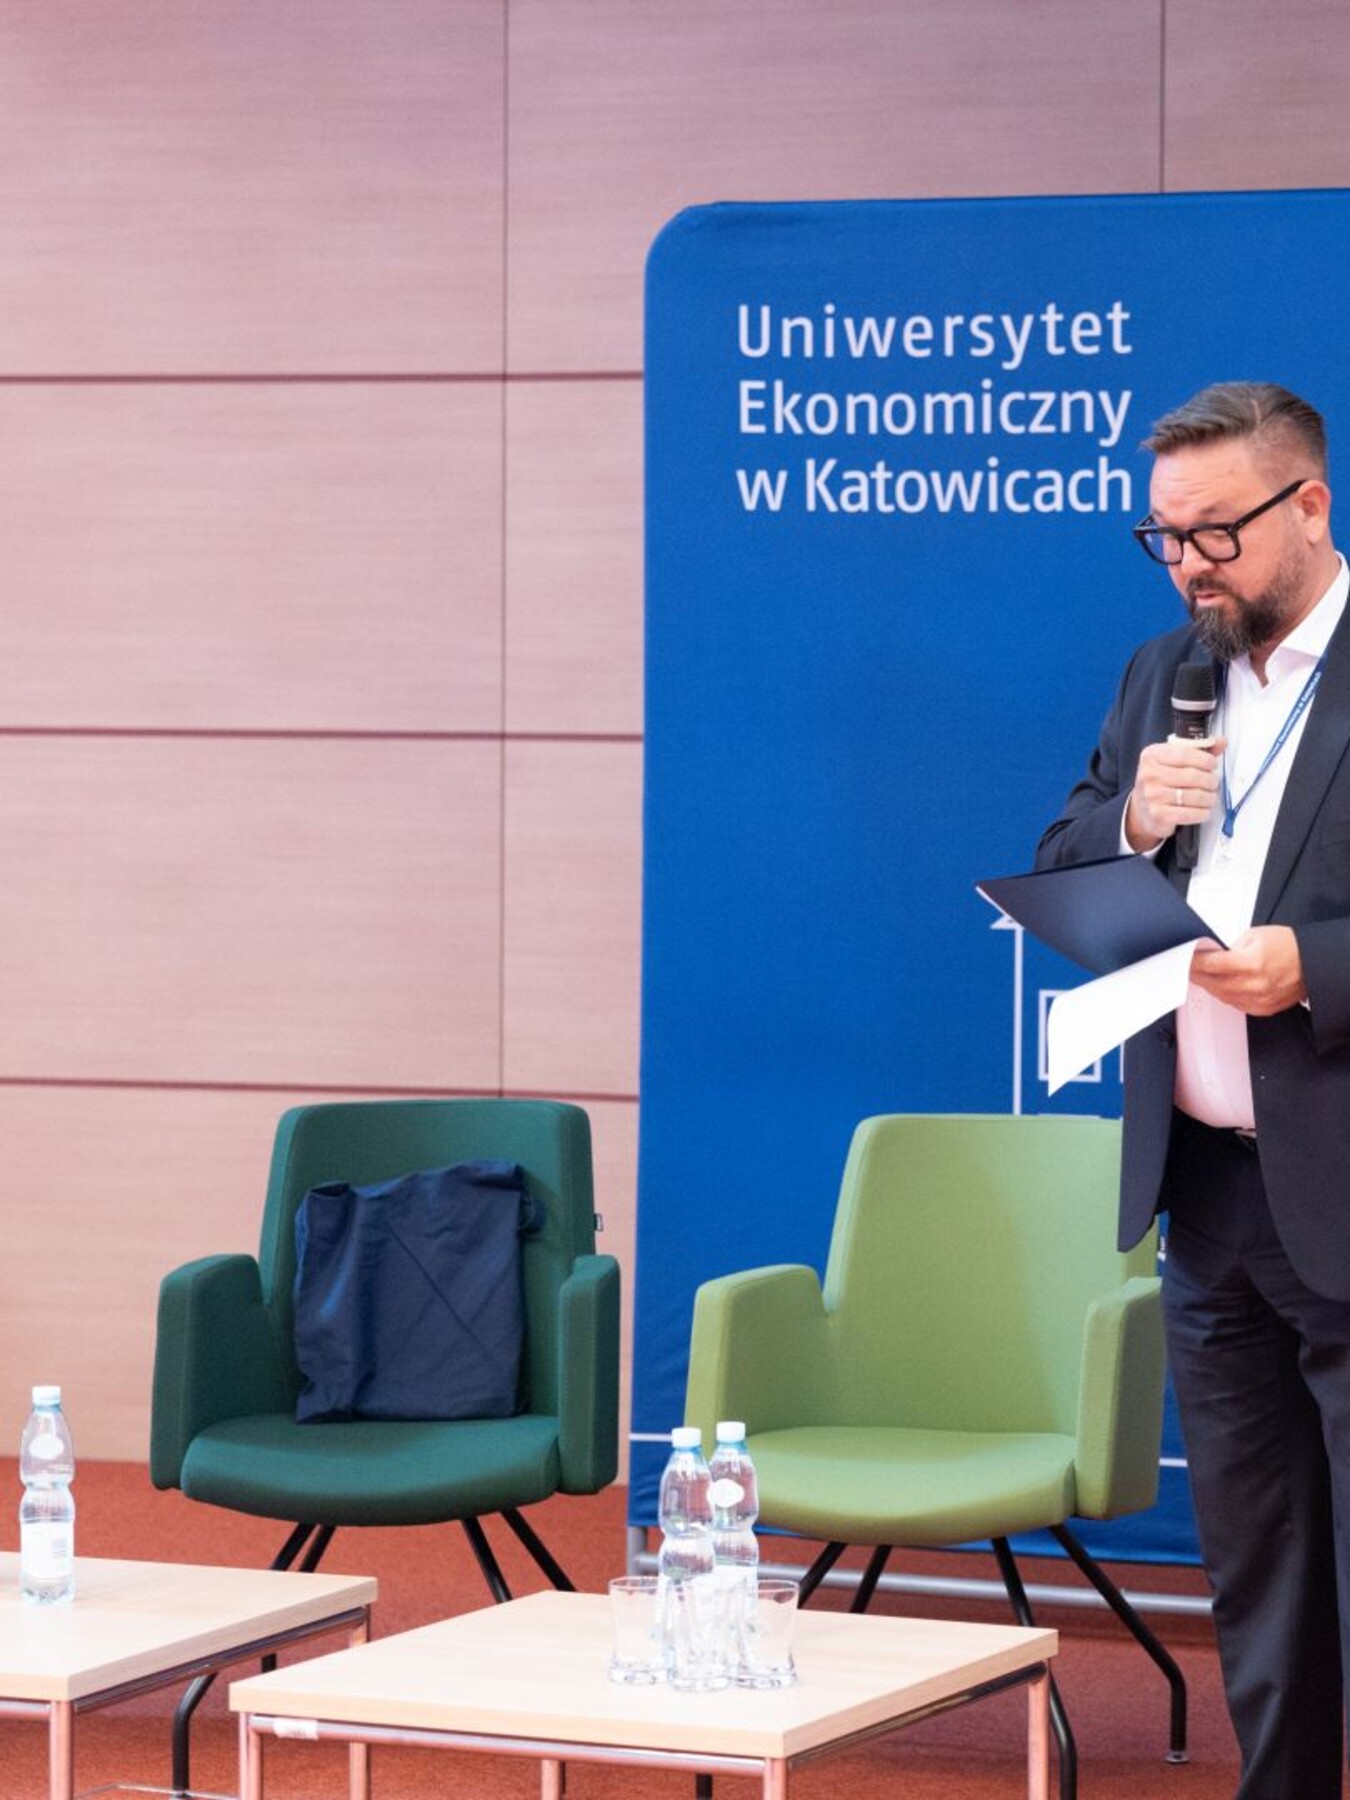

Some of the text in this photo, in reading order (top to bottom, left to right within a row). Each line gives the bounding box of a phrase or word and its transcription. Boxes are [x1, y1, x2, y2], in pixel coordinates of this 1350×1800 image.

[738, 301, 1133, 370] Uniwersytet
[738, 378, 1133, 448] Ekonomiczny
[735, 455, 1132, 513] w Katowicach
